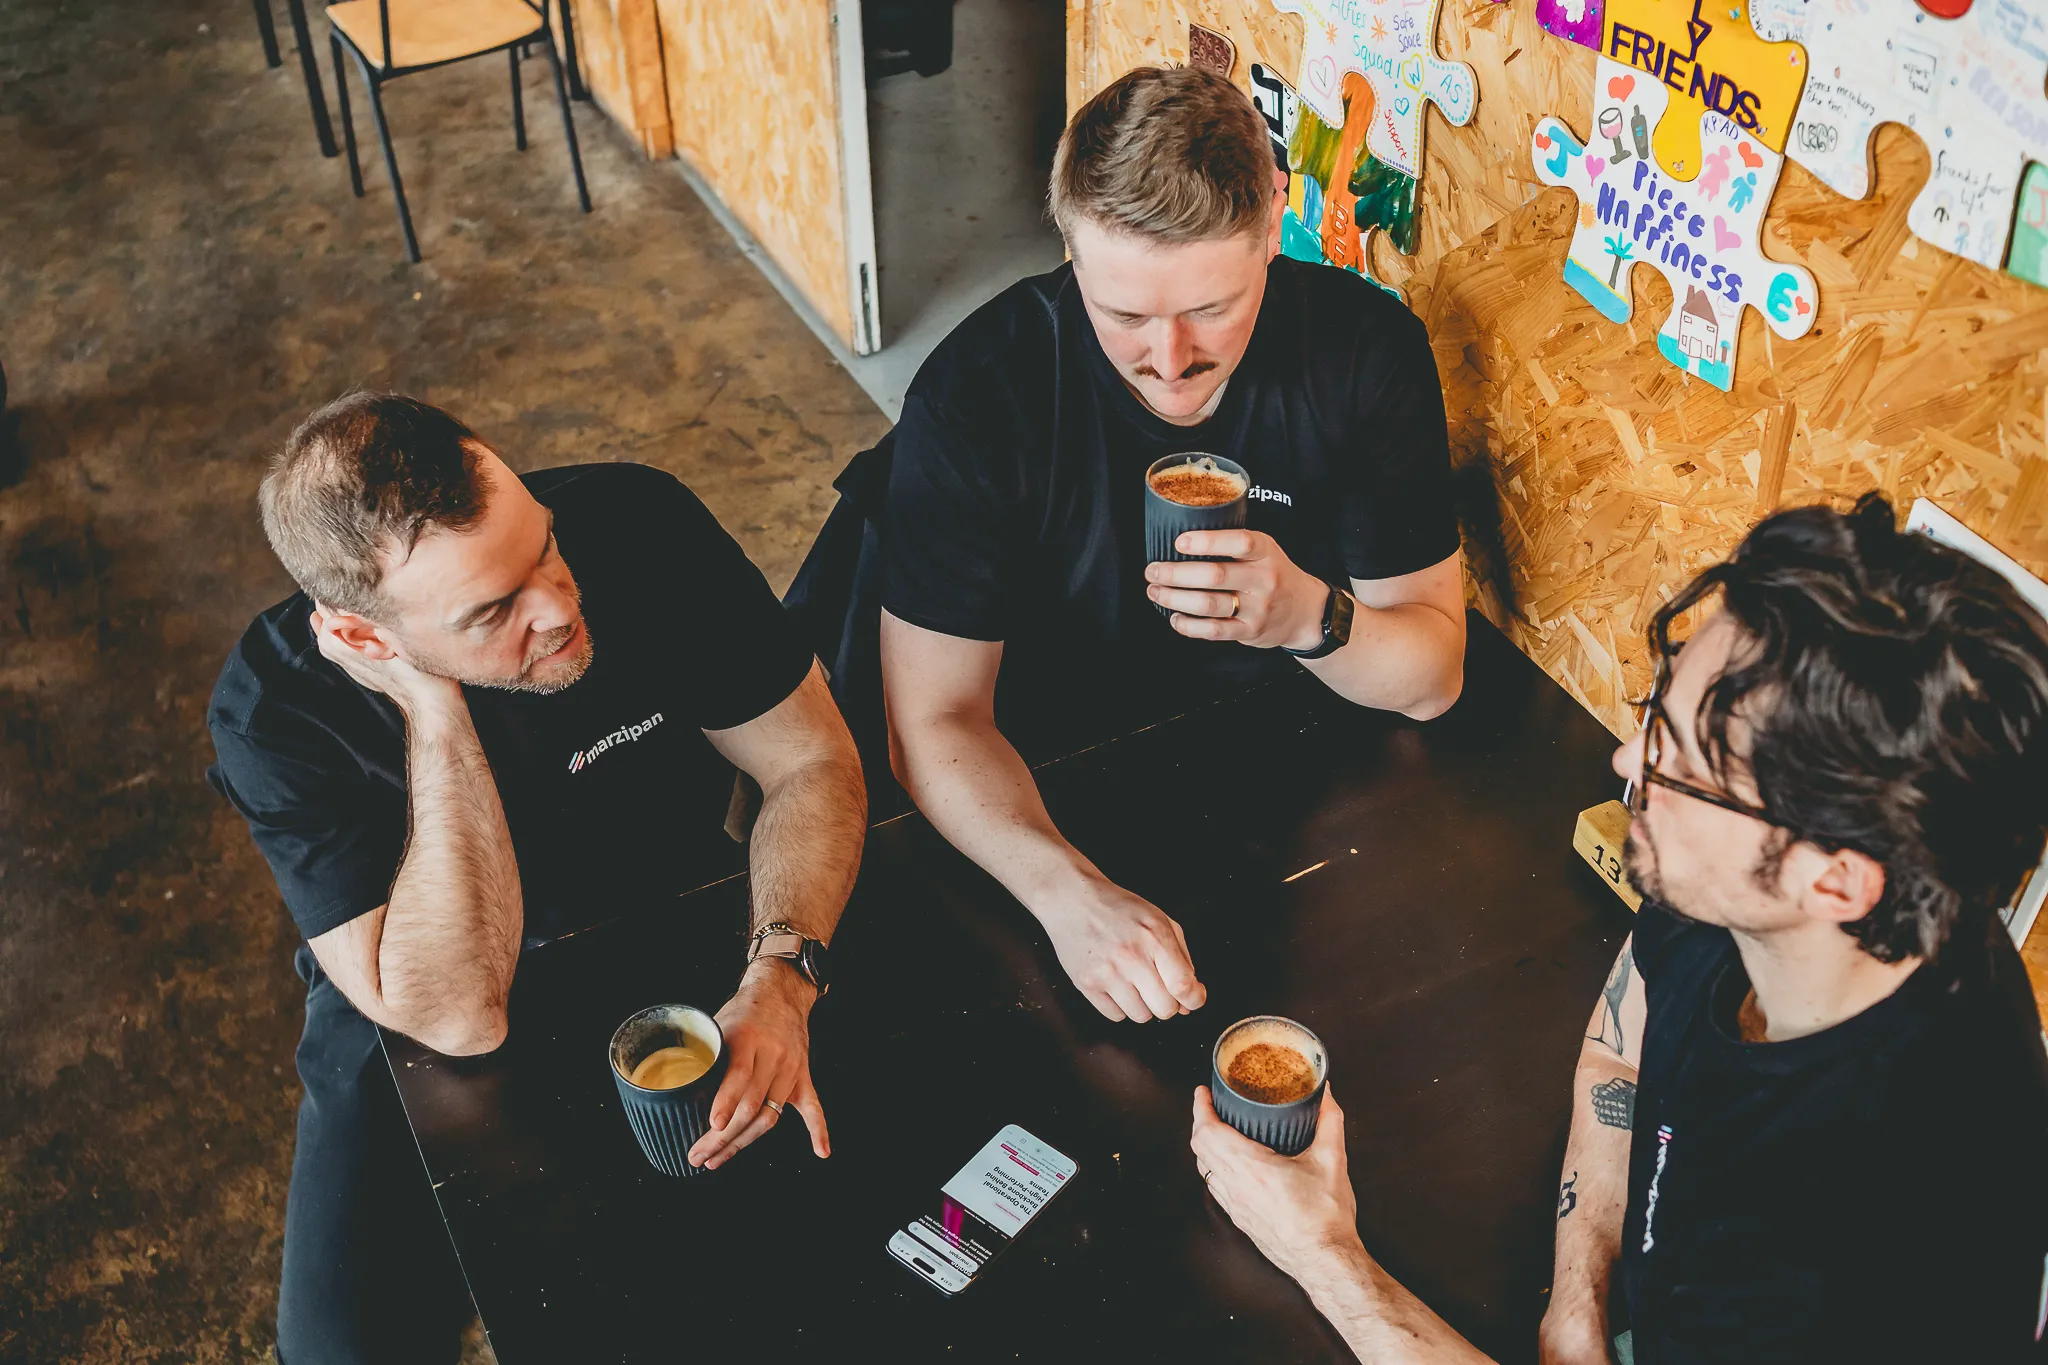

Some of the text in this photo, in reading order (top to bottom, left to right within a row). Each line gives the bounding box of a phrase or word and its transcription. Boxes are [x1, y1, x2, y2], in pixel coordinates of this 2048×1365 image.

[1393, 11, 1415, 31] Safe
[1610, 21, 1762, 130] FRIENDS
[1383, 109, 1408, 161] Support
[586, 712, 664, 765] marzipan
[1591, 844, 1621, 885] 13
[981, 1179, 1021, 1207] Operational
[984, 1171, 1039, 1209] Backbone Behind
[991, 1165, 1046, 1203] High-Performing
[1027, 1179, 1050, 1196] Teams
[1016, 1202, 1033, 1215] The
